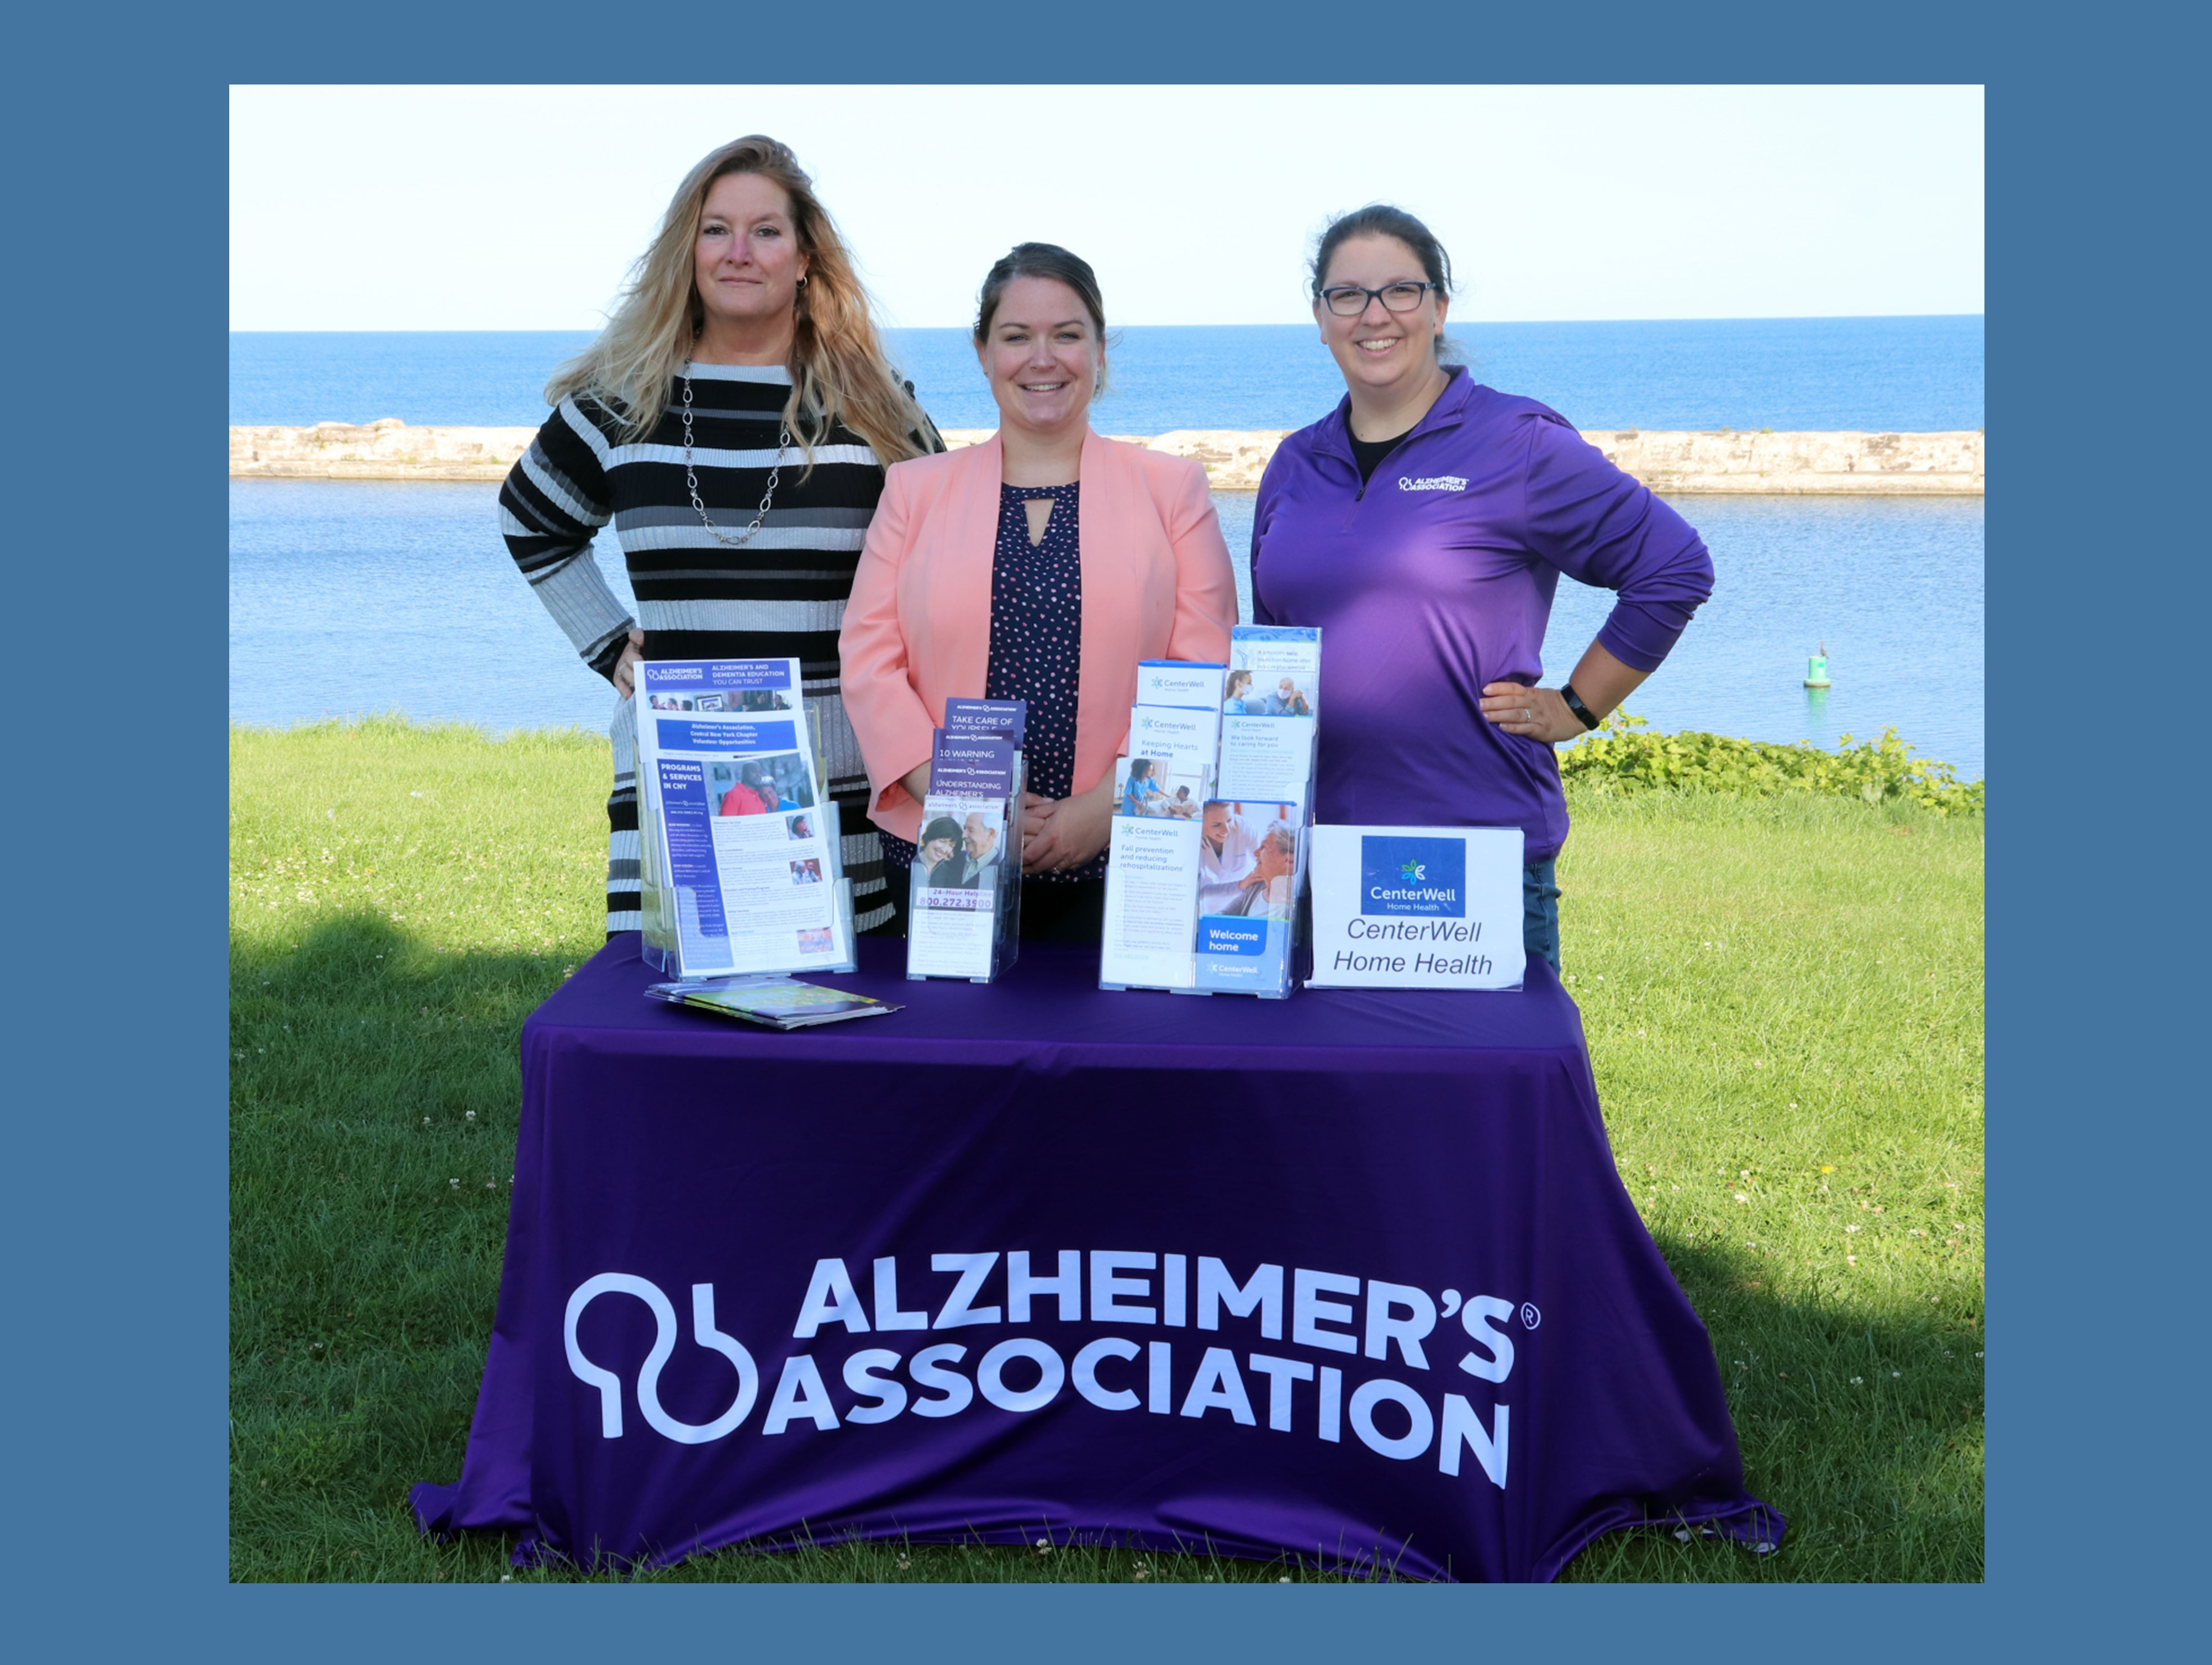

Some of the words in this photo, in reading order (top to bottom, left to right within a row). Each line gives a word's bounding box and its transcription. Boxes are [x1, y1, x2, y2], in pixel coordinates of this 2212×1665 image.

[1414, 475, 1467, 485] ALZHEIMER'S
[1410, 482, 1466, 491] ASSOCIATION
[1164, 679, 1204, 688] CenterWell
[952, 715, 973, 724] TAKE
[975, 716, 999, 725] CARE
[1154, 721, 1196, 731] CenterWell
[1142, 739, 1172, 749] Keeping
[1174, 742, 1198, 750] Hearts
[939, 749, 951, 758] 10
[952, 750, 995, 759] WARNING
[1150, 749, 1174, 758] Home
[661, 764, 701, 772] PROGRAMS
[936, 779, 1001, 790] UNDERSTANDING
[935, 789, 984, 797] ALZHEIMER'S
[1135, 827, 1178, 837] CenterWell
[1135, 846, 1174, 854] prevention
[1135, 855, 1167, 864] reducing
[1120, 862, 1183, 872] rehospitalizations
[1370, 886, 1456, 902] CenterWell
[920, 897, 991, 908] 800.272.3900
[1413, 903, 1440, 911] Health
[1210, 929, 1259, 941] Welcome
[1347, 918, 1482, 942] CenterWell
[1209, 941, 1239, 952] home
[1333, 950, 1406, 972] Home
[1414, 953, 1493, 975] Health
[1218, 965, 1258, 974] CenterWell
[793, 1251, 1514, 1383] ALZHEIMER'S
[762, 1338, 1510, 1490] ASSOCIATION
